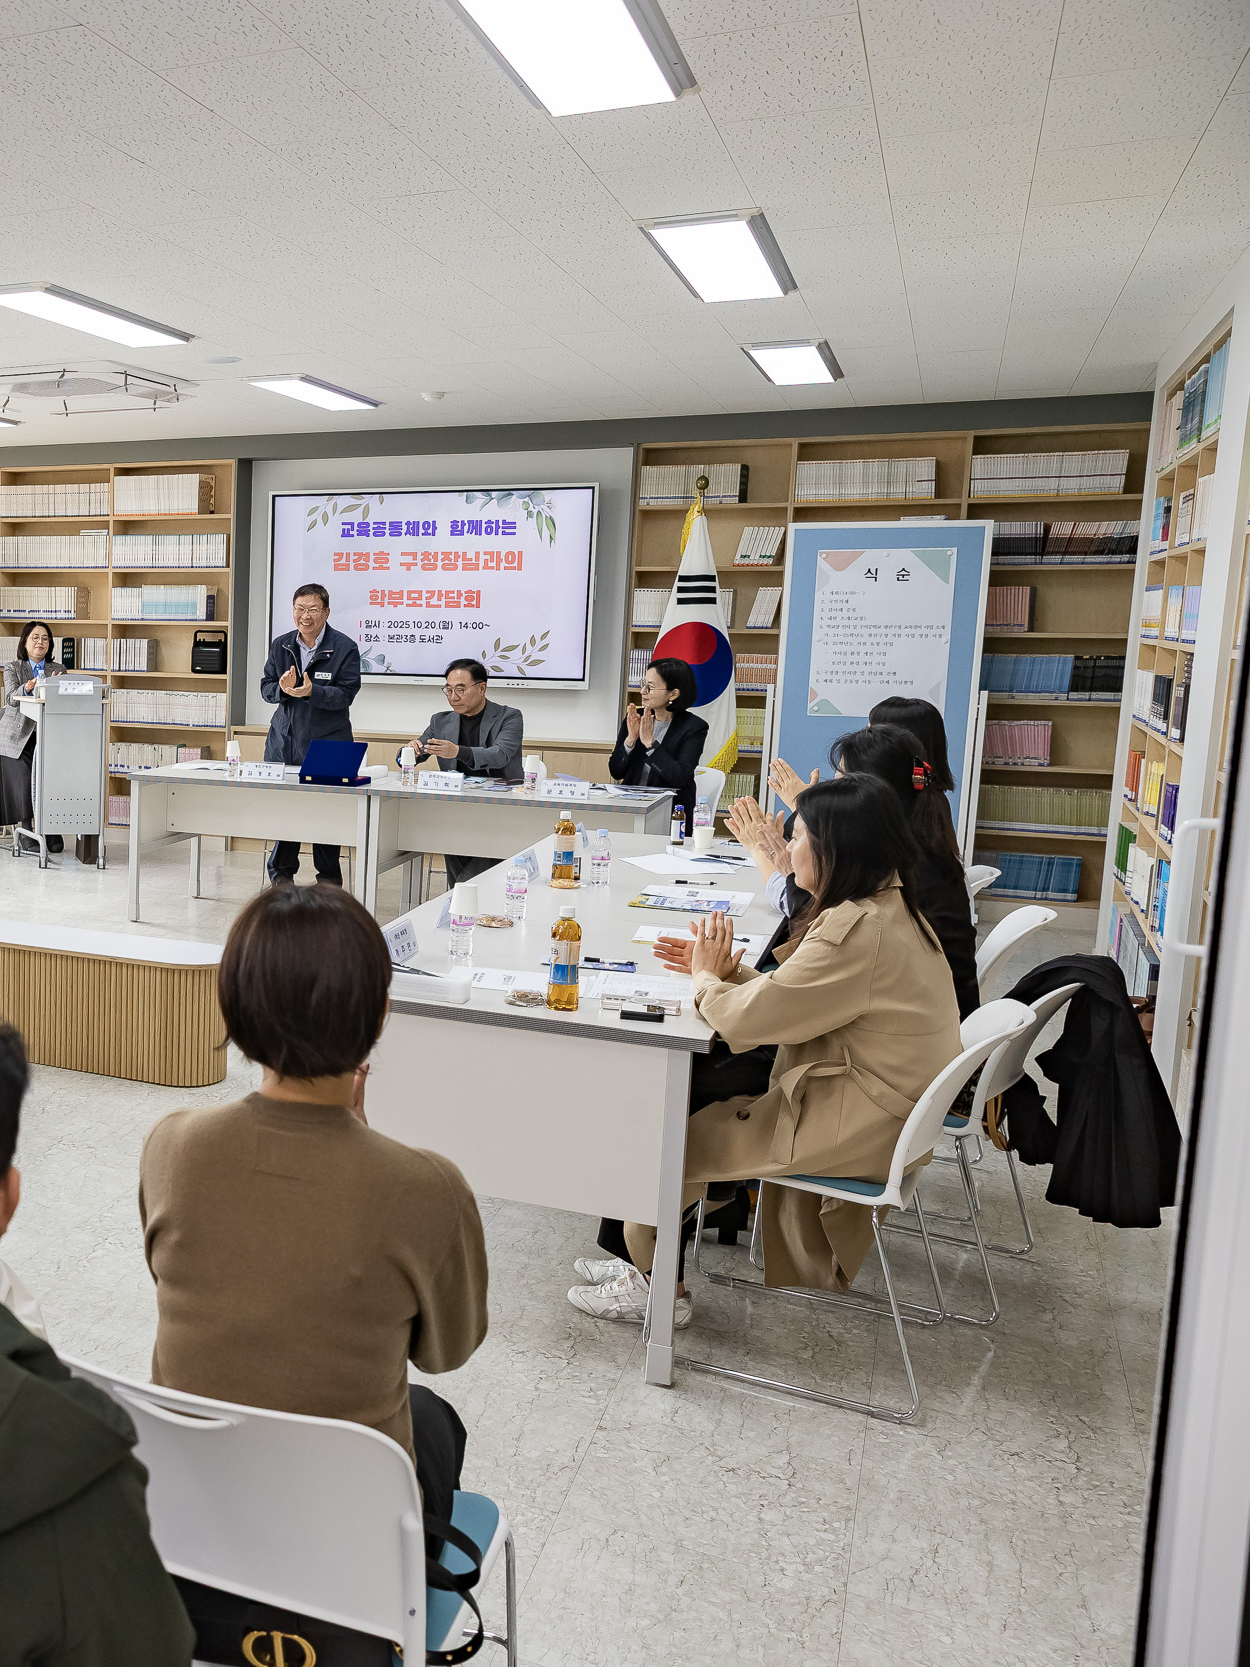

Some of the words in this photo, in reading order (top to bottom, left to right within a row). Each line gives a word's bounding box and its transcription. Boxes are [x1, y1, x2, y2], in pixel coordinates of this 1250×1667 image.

[341, 520, 437, 537] 교육공동체와
[450, 519, 517, 536] 함께하는
[333, 551, 390, 571] 김경호
[400, 550, 523, 571] 구청장님과의
[369, 589, 481, 609] 학부모간담회
[365, 620, 380, 629] 일시
[387, 620, 453, 630] 2025.10.20.(월)
[458, 621, 490, 630] 14:00~
[365, 634, 380, 643] 장소
[387, 634, 416, 643] 본관3층
[419, 635, 443, 644] 도서관
